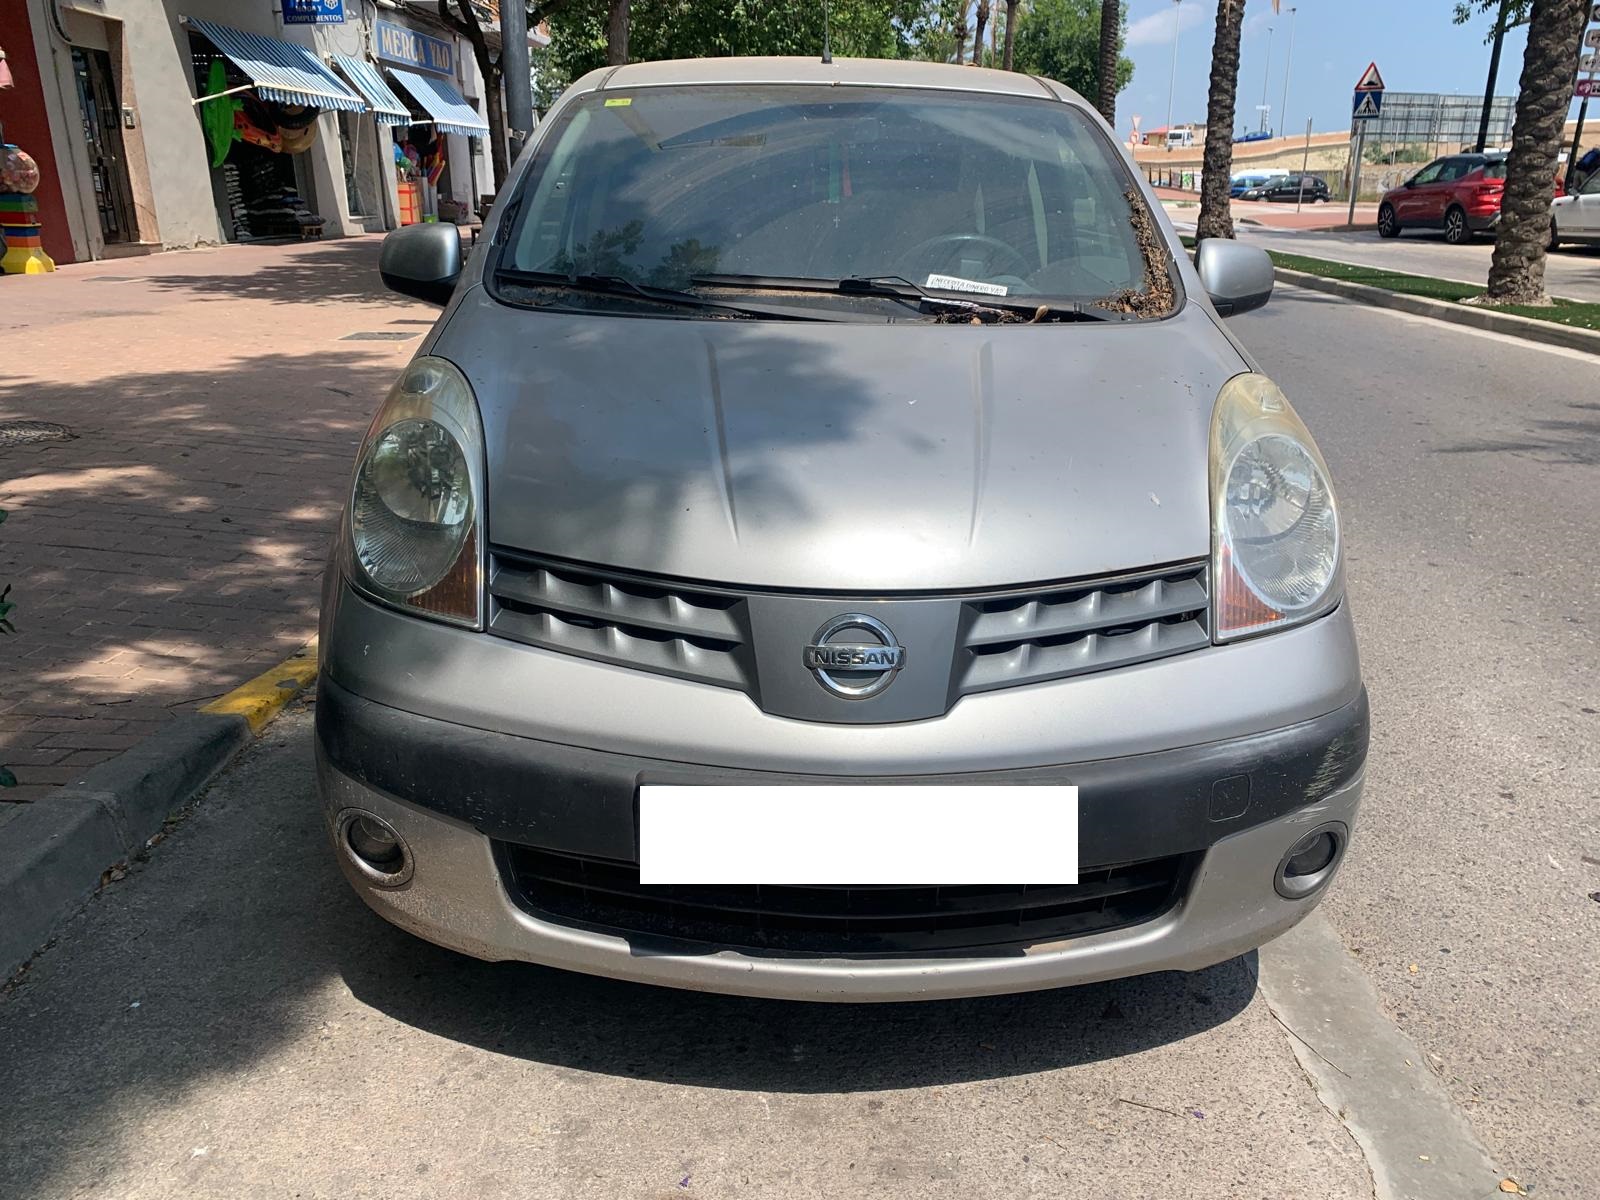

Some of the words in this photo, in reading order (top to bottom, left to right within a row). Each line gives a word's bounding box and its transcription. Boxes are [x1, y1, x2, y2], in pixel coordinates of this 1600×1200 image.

[286, 14, 343, 22] COMPLEMENTOS
[381, 26, 426, 65] MERCA
[814, 648, 895, 665] NISSAN
